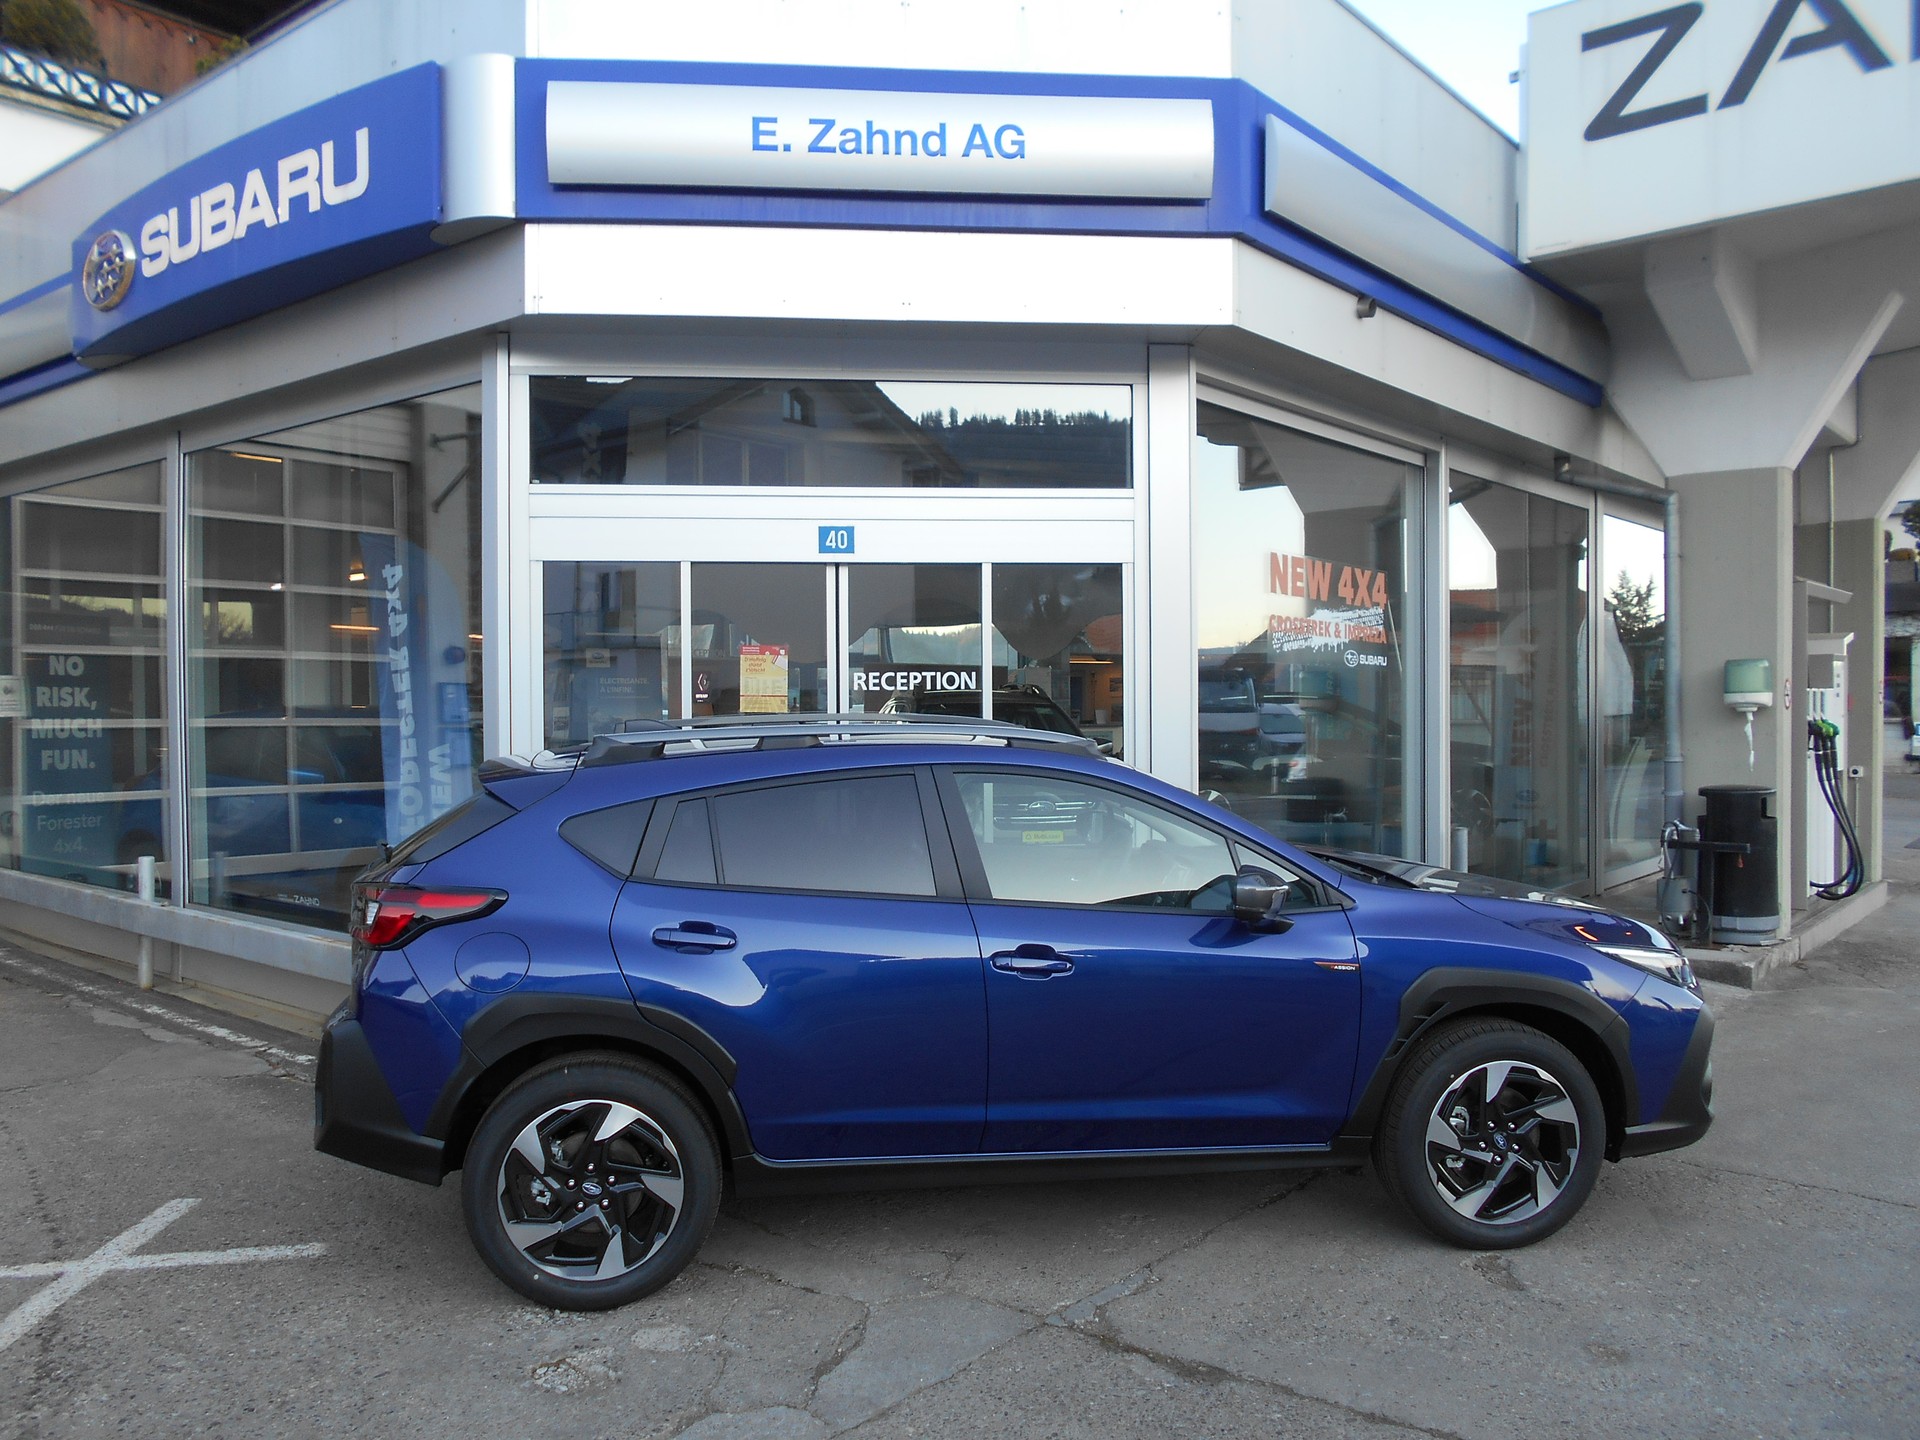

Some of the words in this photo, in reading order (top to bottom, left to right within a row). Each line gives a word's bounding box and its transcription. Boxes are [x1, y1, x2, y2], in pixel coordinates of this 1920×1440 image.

[1581, 0, 1920, 142] ZA
[751, 115, 792, 153] E.
[808, 118, 947, 157] Zahnd
[962, 122, 1027, 160] AG
[141, 127, 370, 278] SUBARU
[825, 530, 848, 549] 40
[1269, 551, 1332, 602] NEW
[1338, 565, 1388, 609] 4X4
[1268, 613, 1332, 639] CROSSTREK
[1333, 622, 1342, 639] &
[1344, 624, 1387, 645] IMPREZA
[49, 655, 85, 676] NO
[1359, 653, 1388, 668] SUBARU
[853, 671, 977, 692] RECEPTION
[36, 686, 98, 711] RISK,
[31, 718, 103, 739] MUCH
[41, 749, 96, 771] FUN.
[37, 813, 103, 832] Forester
